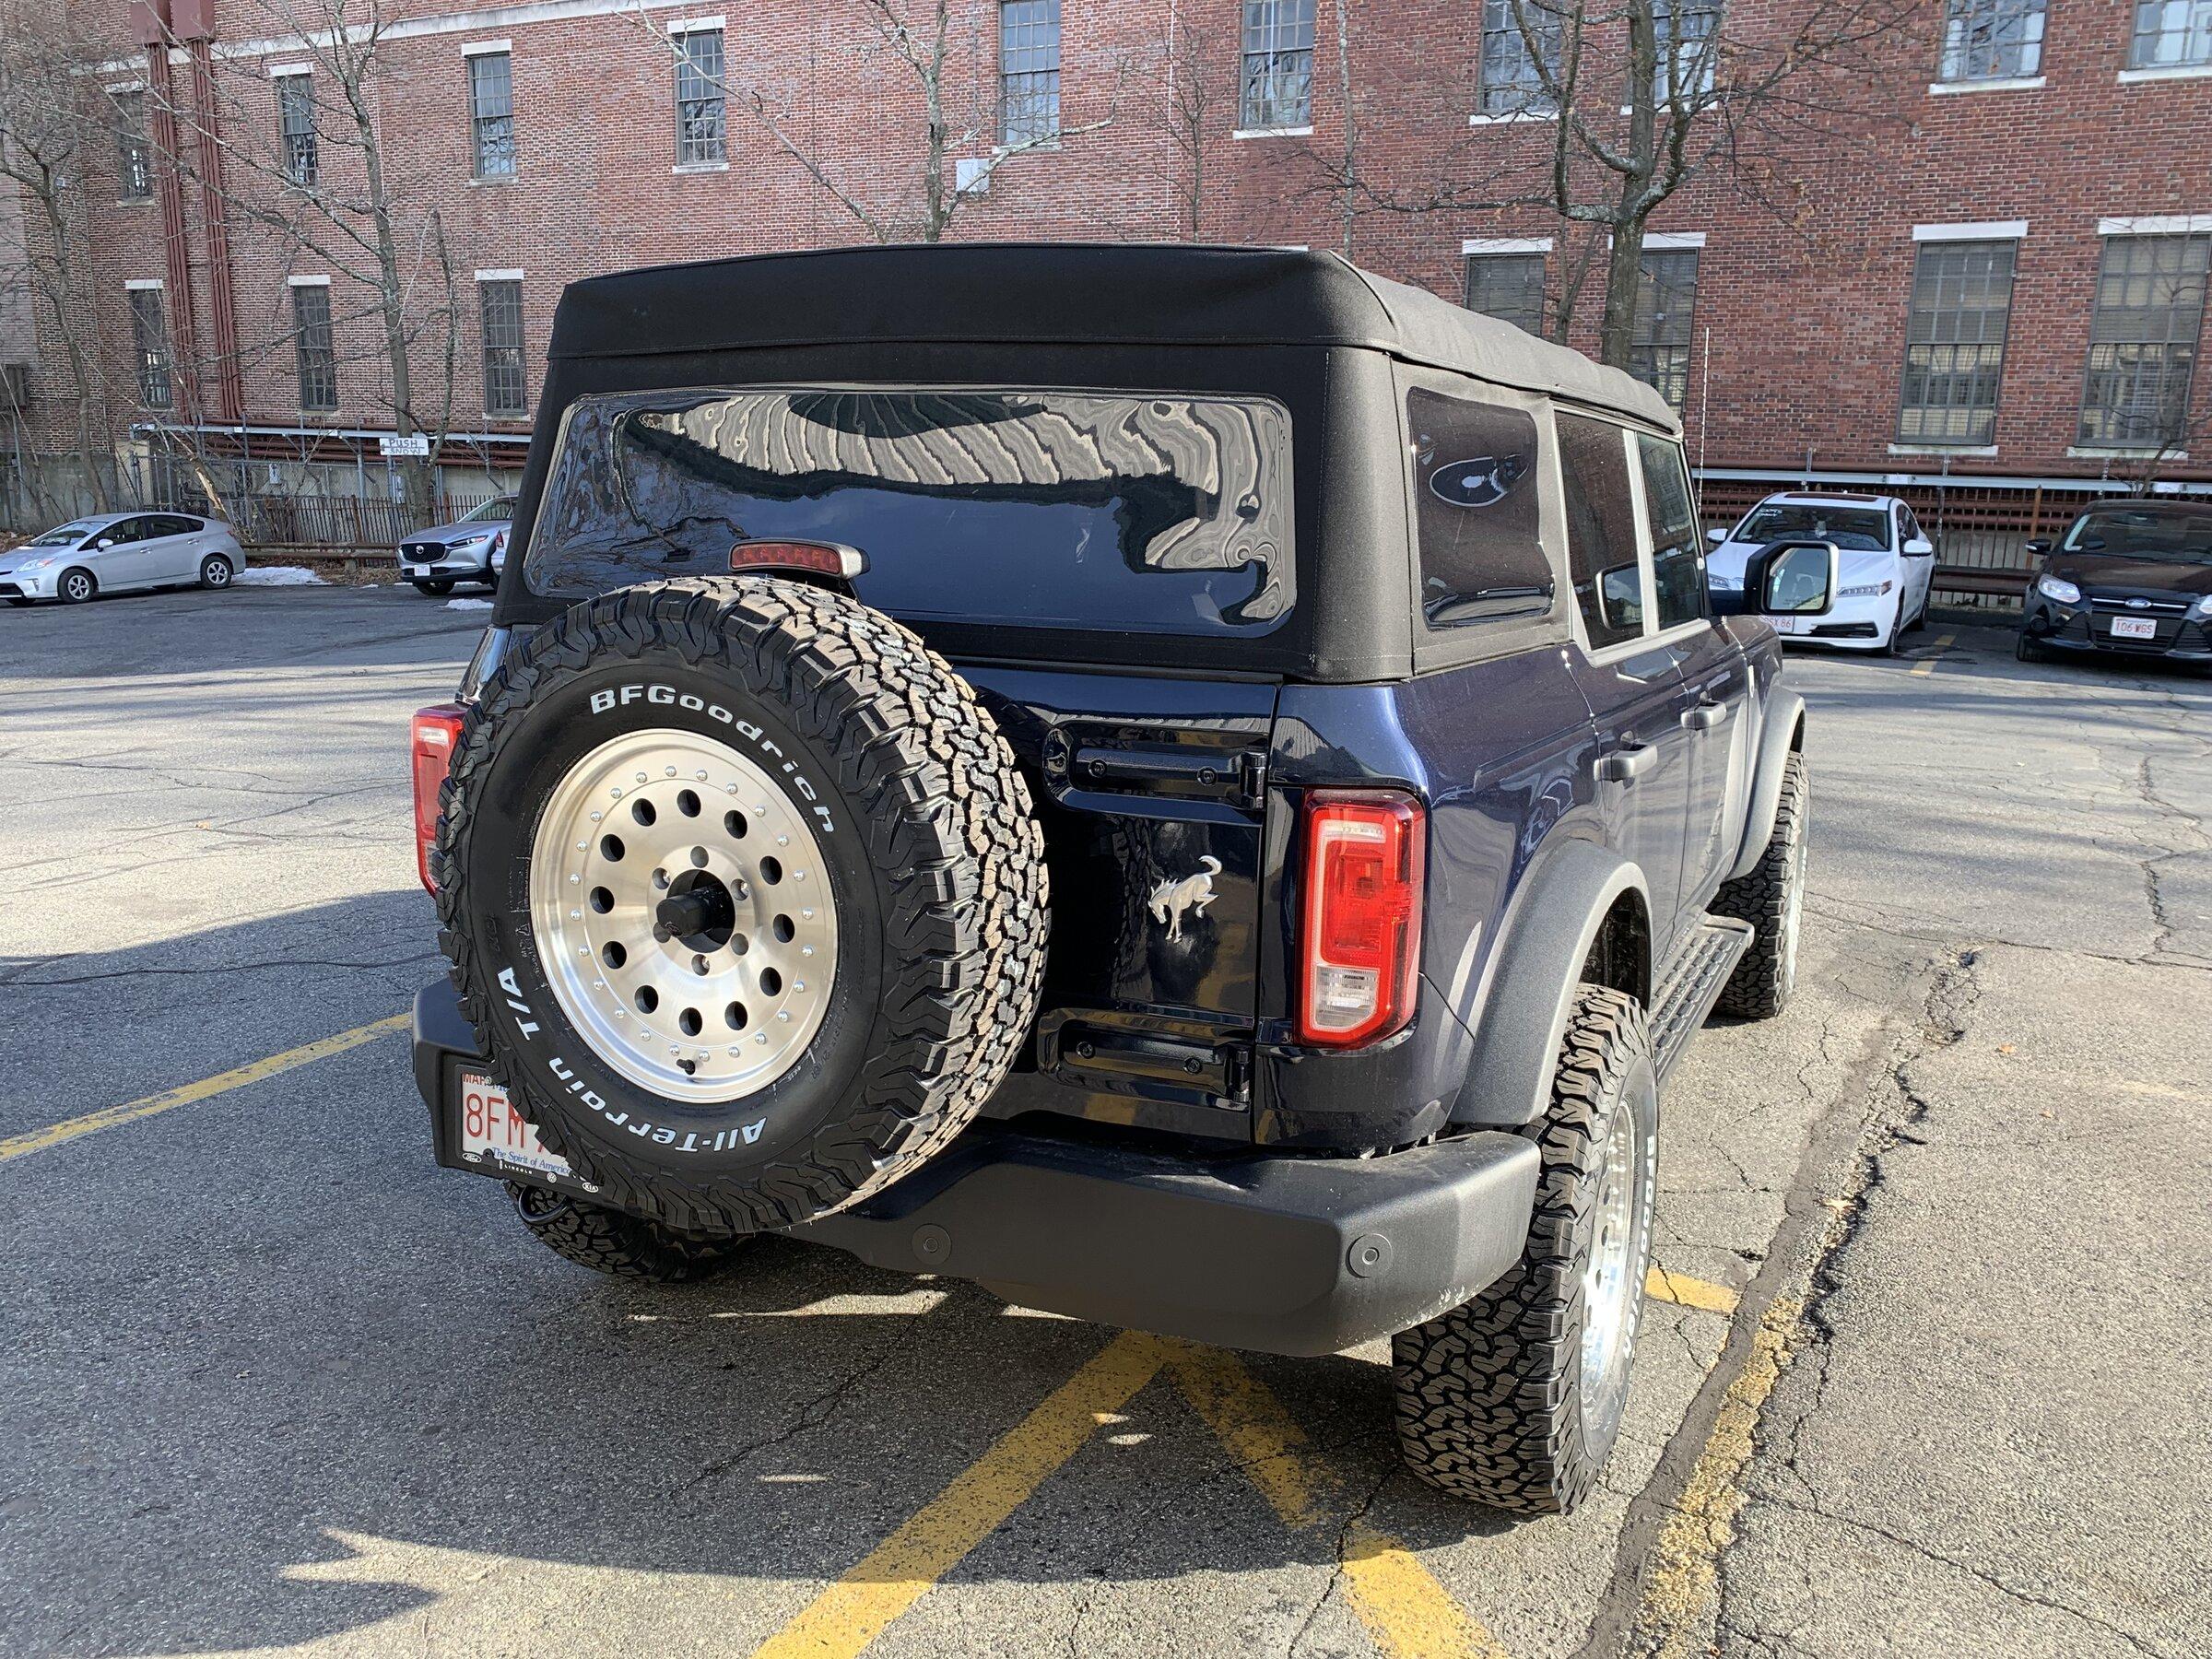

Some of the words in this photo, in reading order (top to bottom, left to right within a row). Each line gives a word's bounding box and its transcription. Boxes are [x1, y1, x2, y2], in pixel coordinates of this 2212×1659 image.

[389, 439, 418, 448] PUSH
[590, 685, 834, 832] BFGoodrich
[498, 967, 540, 1041] T/A
[548, 1057, 767, 1152] All-Terrain
[492, 1147, 506, 1159] The
[508, 1151, 528, 1163] Spirit
[530, 1158, 538, 1167] of
[504, 1163, 533, 1175] LINCOLN
[1622, 1135, 1655, 1359] BFGoodrich
